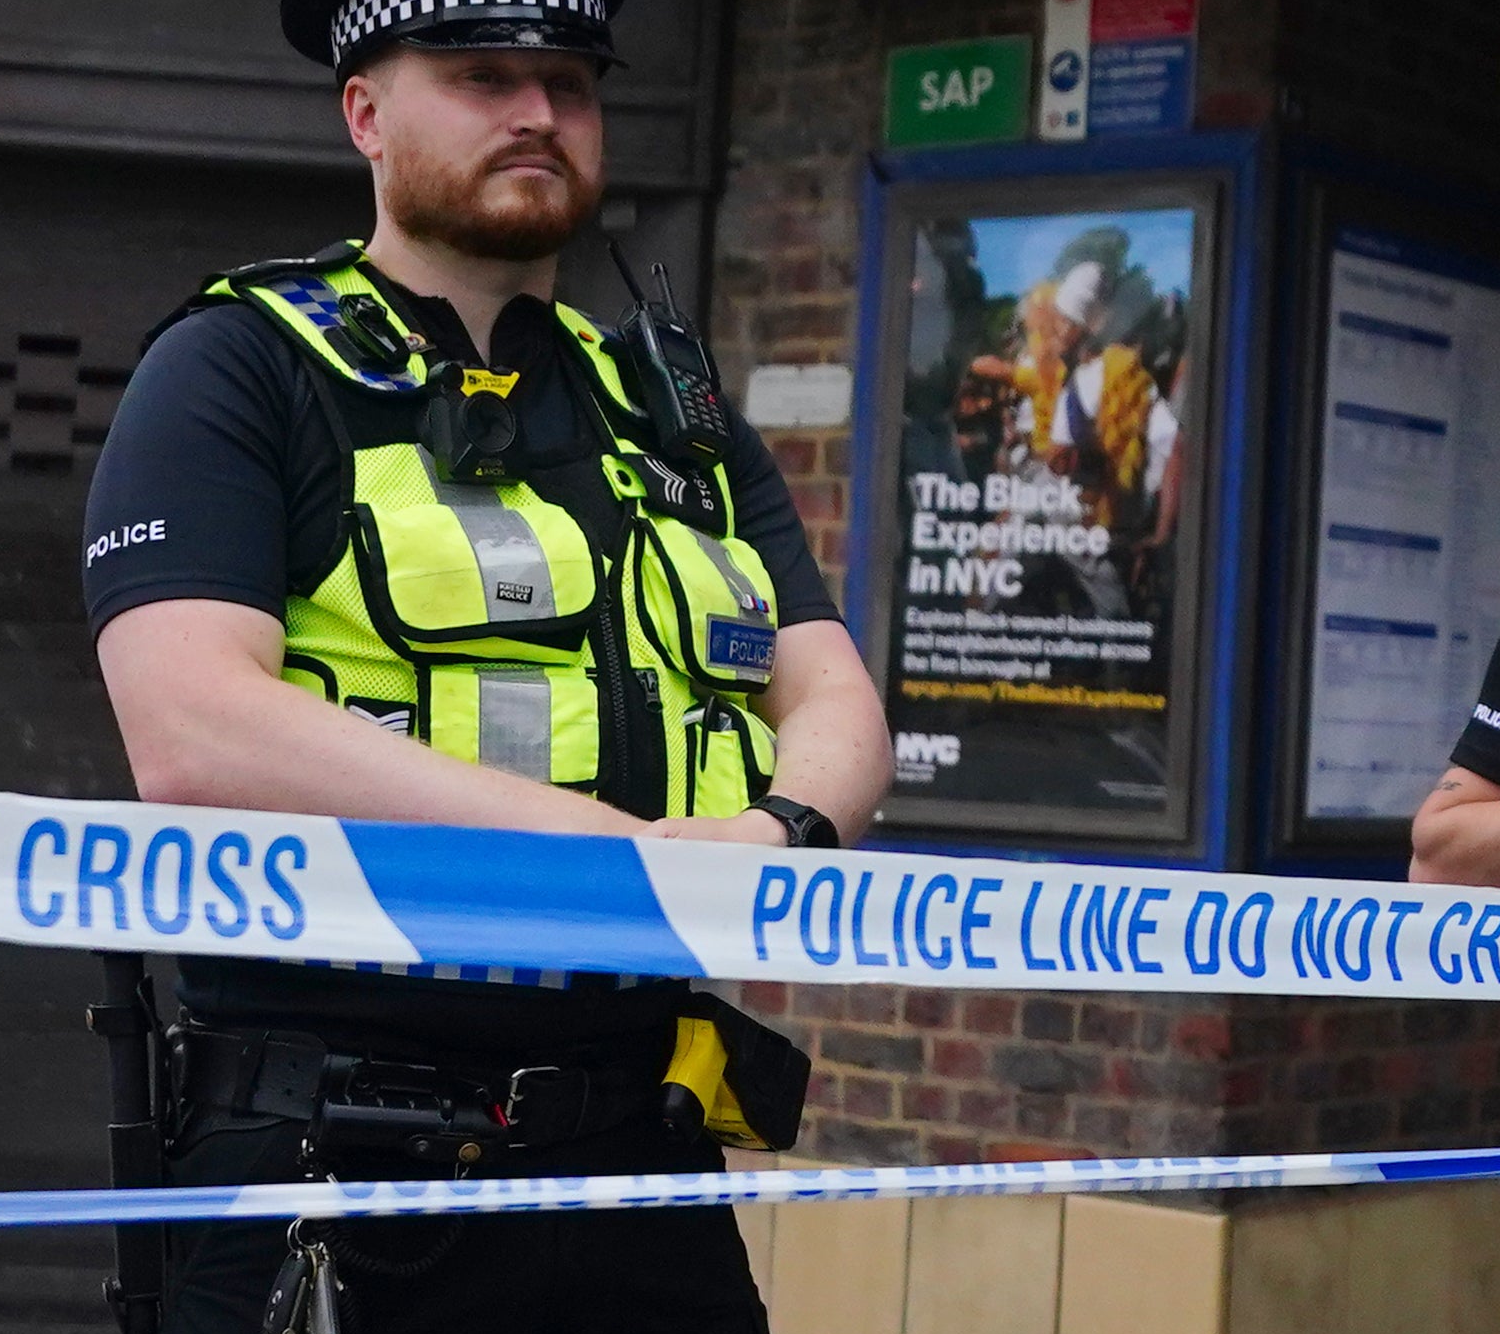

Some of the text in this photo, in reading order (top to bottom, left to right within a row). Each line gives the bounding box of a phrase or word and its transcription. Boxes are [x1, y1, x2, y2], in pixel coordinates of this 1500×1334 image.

[918, 66, 995, 112] SAP
[915, 472, 1084, 517] The Black
[86, 519, 167, 569] POLICE
[911, 512, 1111, 557] Experience
[943, 557, 1024, 598] NYC
[728, 639, 774, 667] POLICE
[16, 816, 309, 942] CROSS
[751, 864, 1004, 971] POLICE
[1020, 880, 1173, 975] LINE
[1183, 890, 1276, 980] DO
[1290, 895, 1424, 983] NOT
